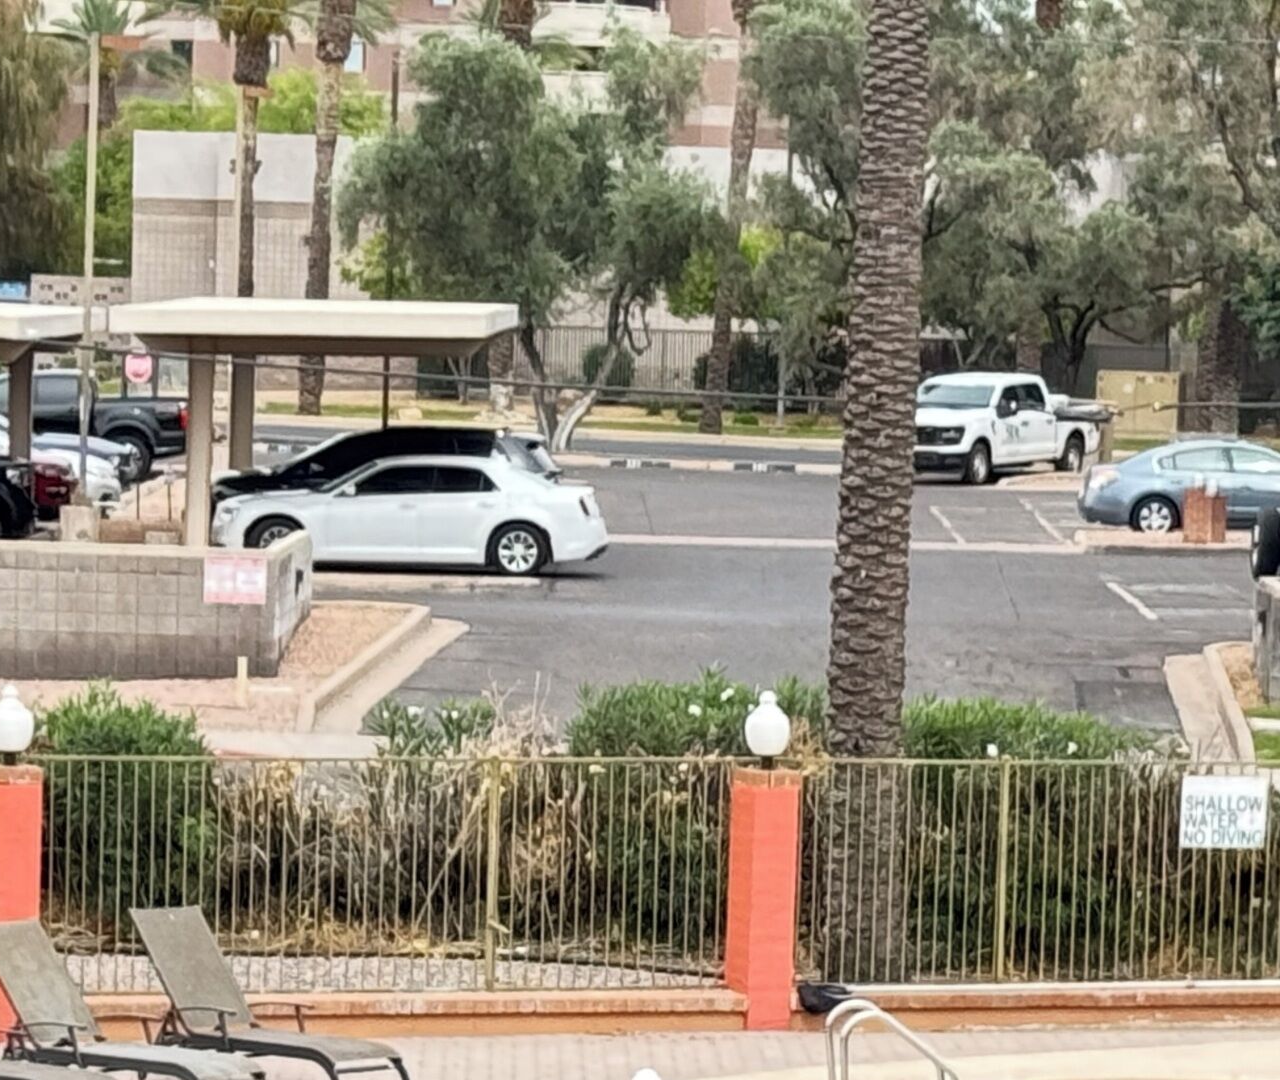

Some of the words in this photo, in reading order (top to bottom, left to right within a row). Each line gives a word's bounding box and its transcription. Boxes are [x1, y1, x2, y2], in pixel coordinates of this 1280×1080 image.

[1185, 795, 1262, 812] SHALLOW
[1184, 810, 1238, 828] WATER
[1184, 829, 1206, 845] NO
[1211, 829, 1262, 845] DIVING
